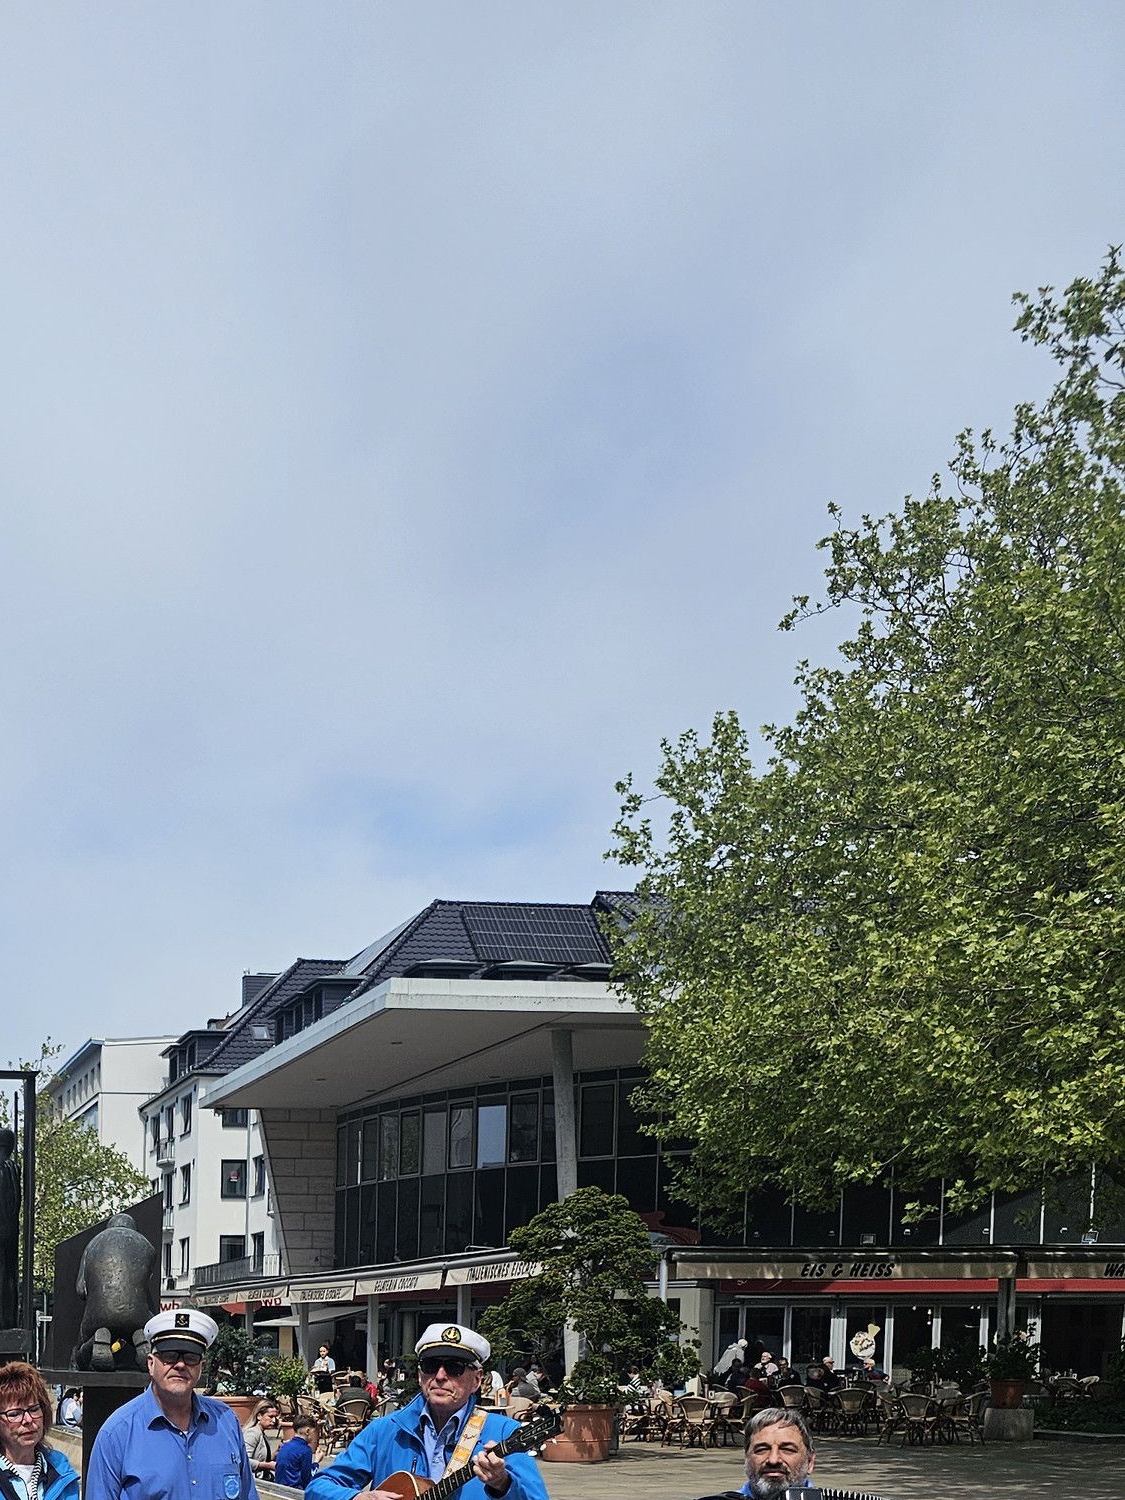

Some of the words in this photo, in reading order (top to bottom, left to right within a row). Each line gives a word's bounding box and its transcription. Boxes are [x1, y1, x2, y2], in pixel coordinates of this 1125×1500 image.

[800, 1263, 826, 1278] EIS
[831, 1263, 843, 1278] &
[849, 1262, 895, 1278] HEISS
